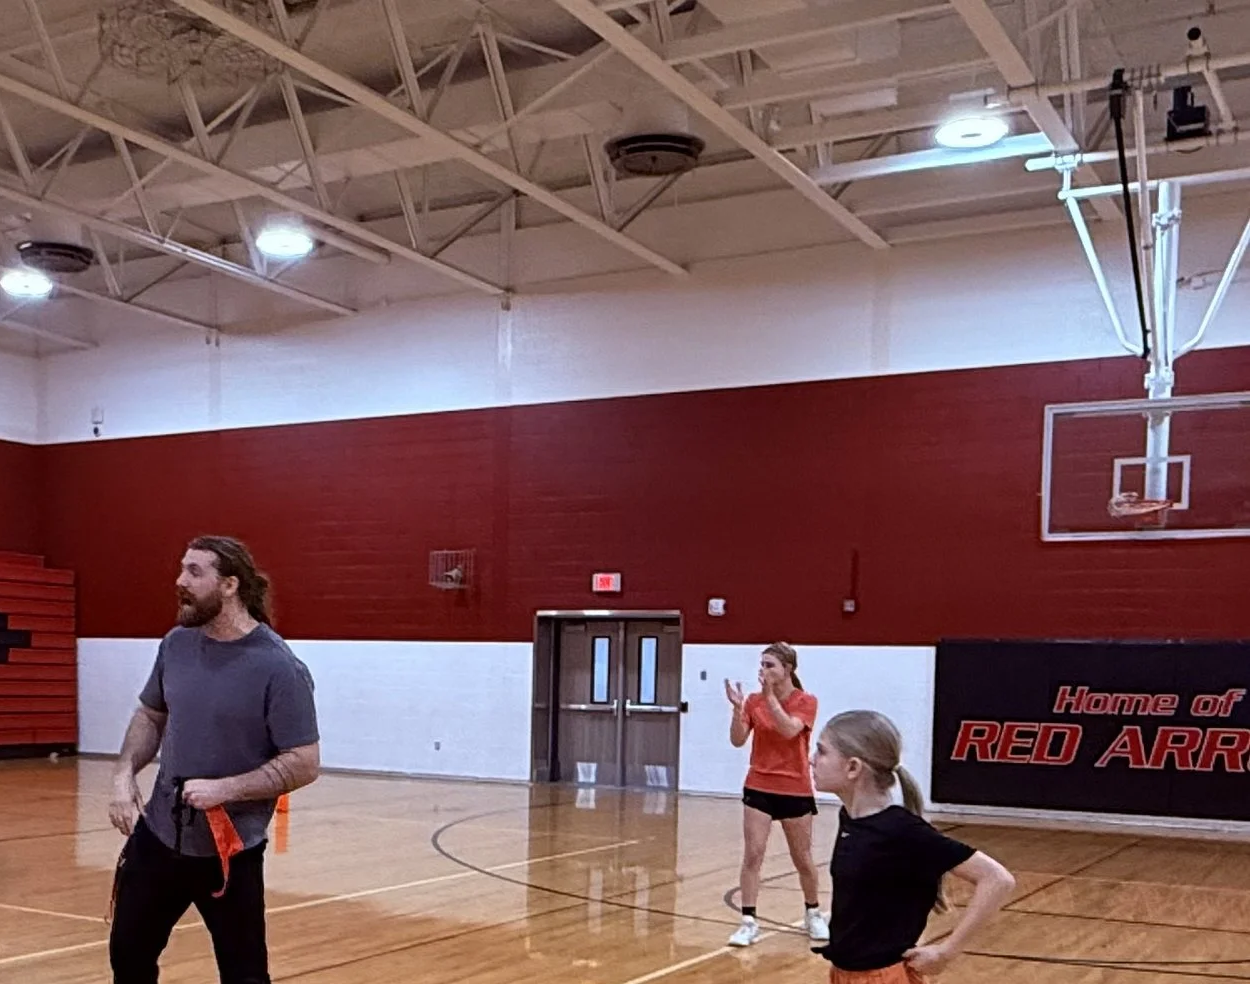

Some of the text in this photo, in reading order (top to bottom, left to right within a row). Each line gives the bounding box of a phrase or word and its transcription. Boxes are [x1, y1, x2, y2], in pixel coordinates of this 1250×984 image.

[1053, 686, 1247, 717] Home of
[951, 720, 1250, 772] RED ARR
